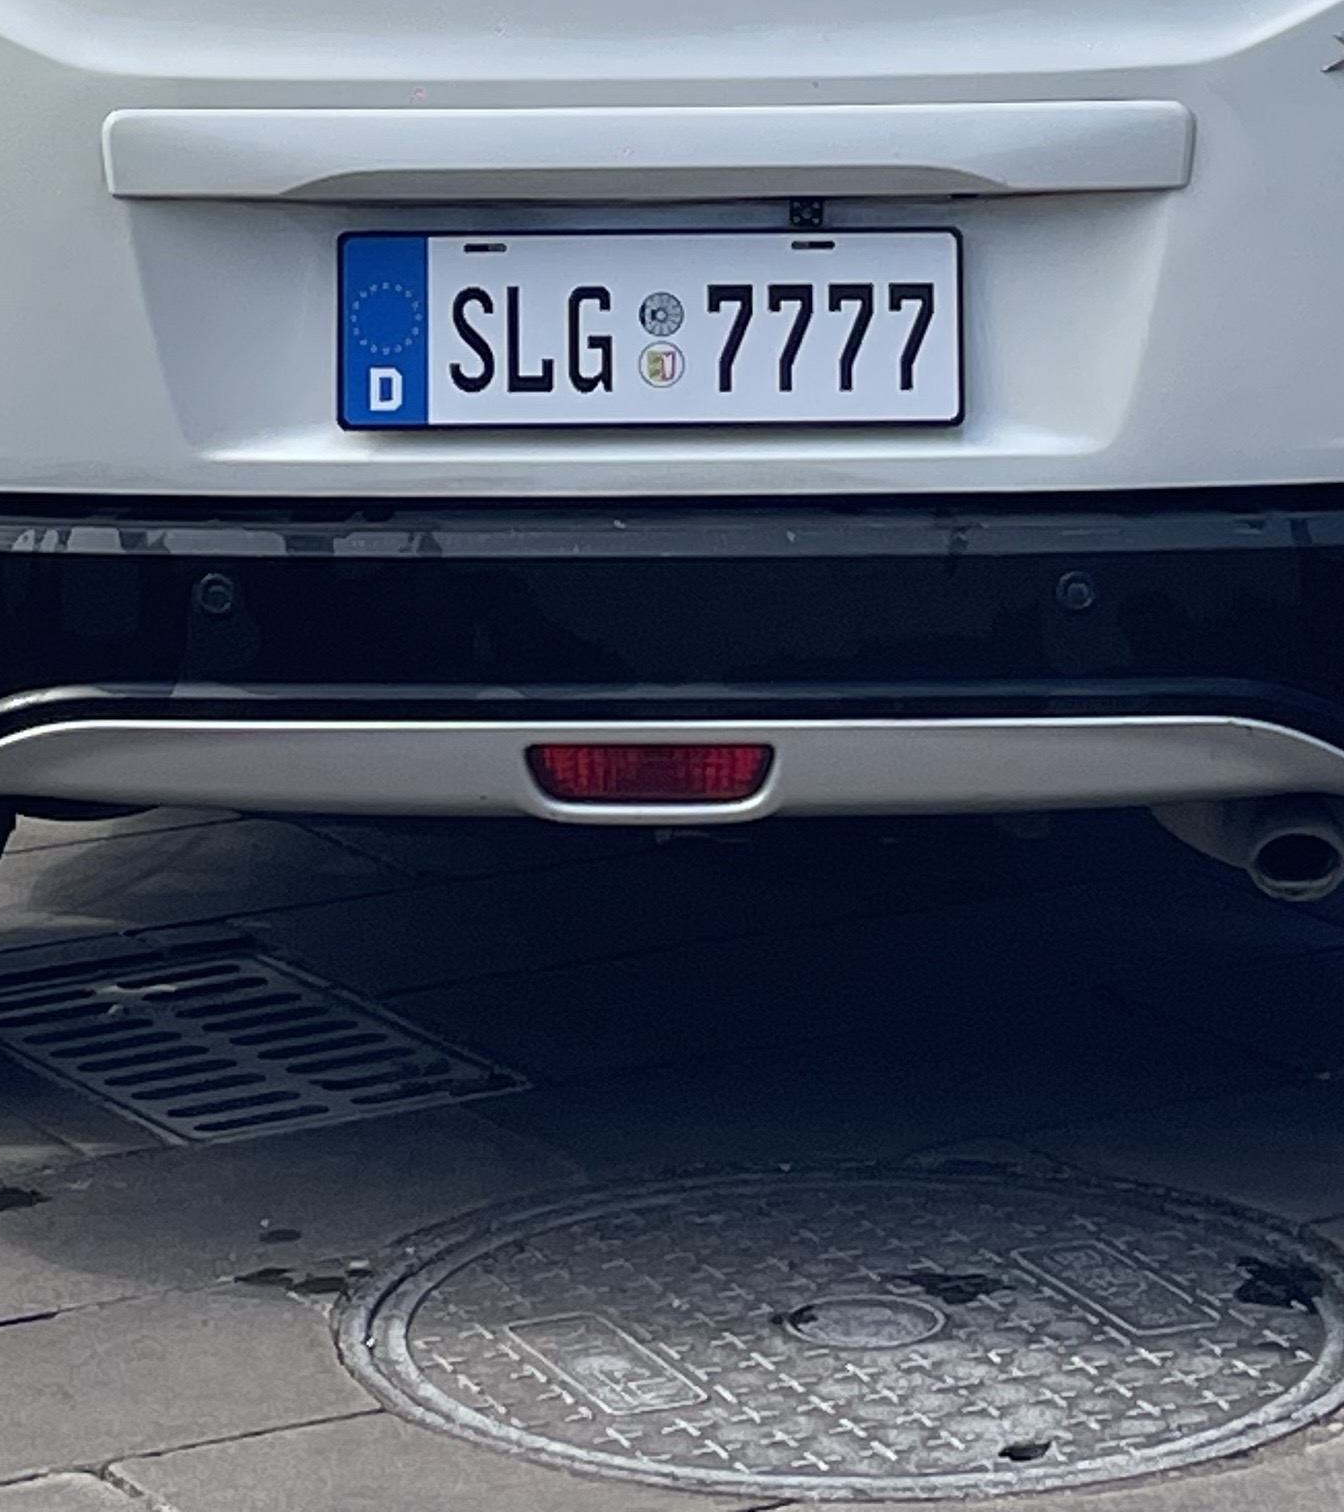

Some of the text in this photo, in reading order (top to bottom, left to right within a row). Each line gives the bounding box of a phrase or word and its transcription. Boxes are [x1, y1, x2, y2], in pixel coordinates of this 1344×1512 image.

[448, 282, 935, 393] SLG 7777
[369, 366, 403, 412] D
